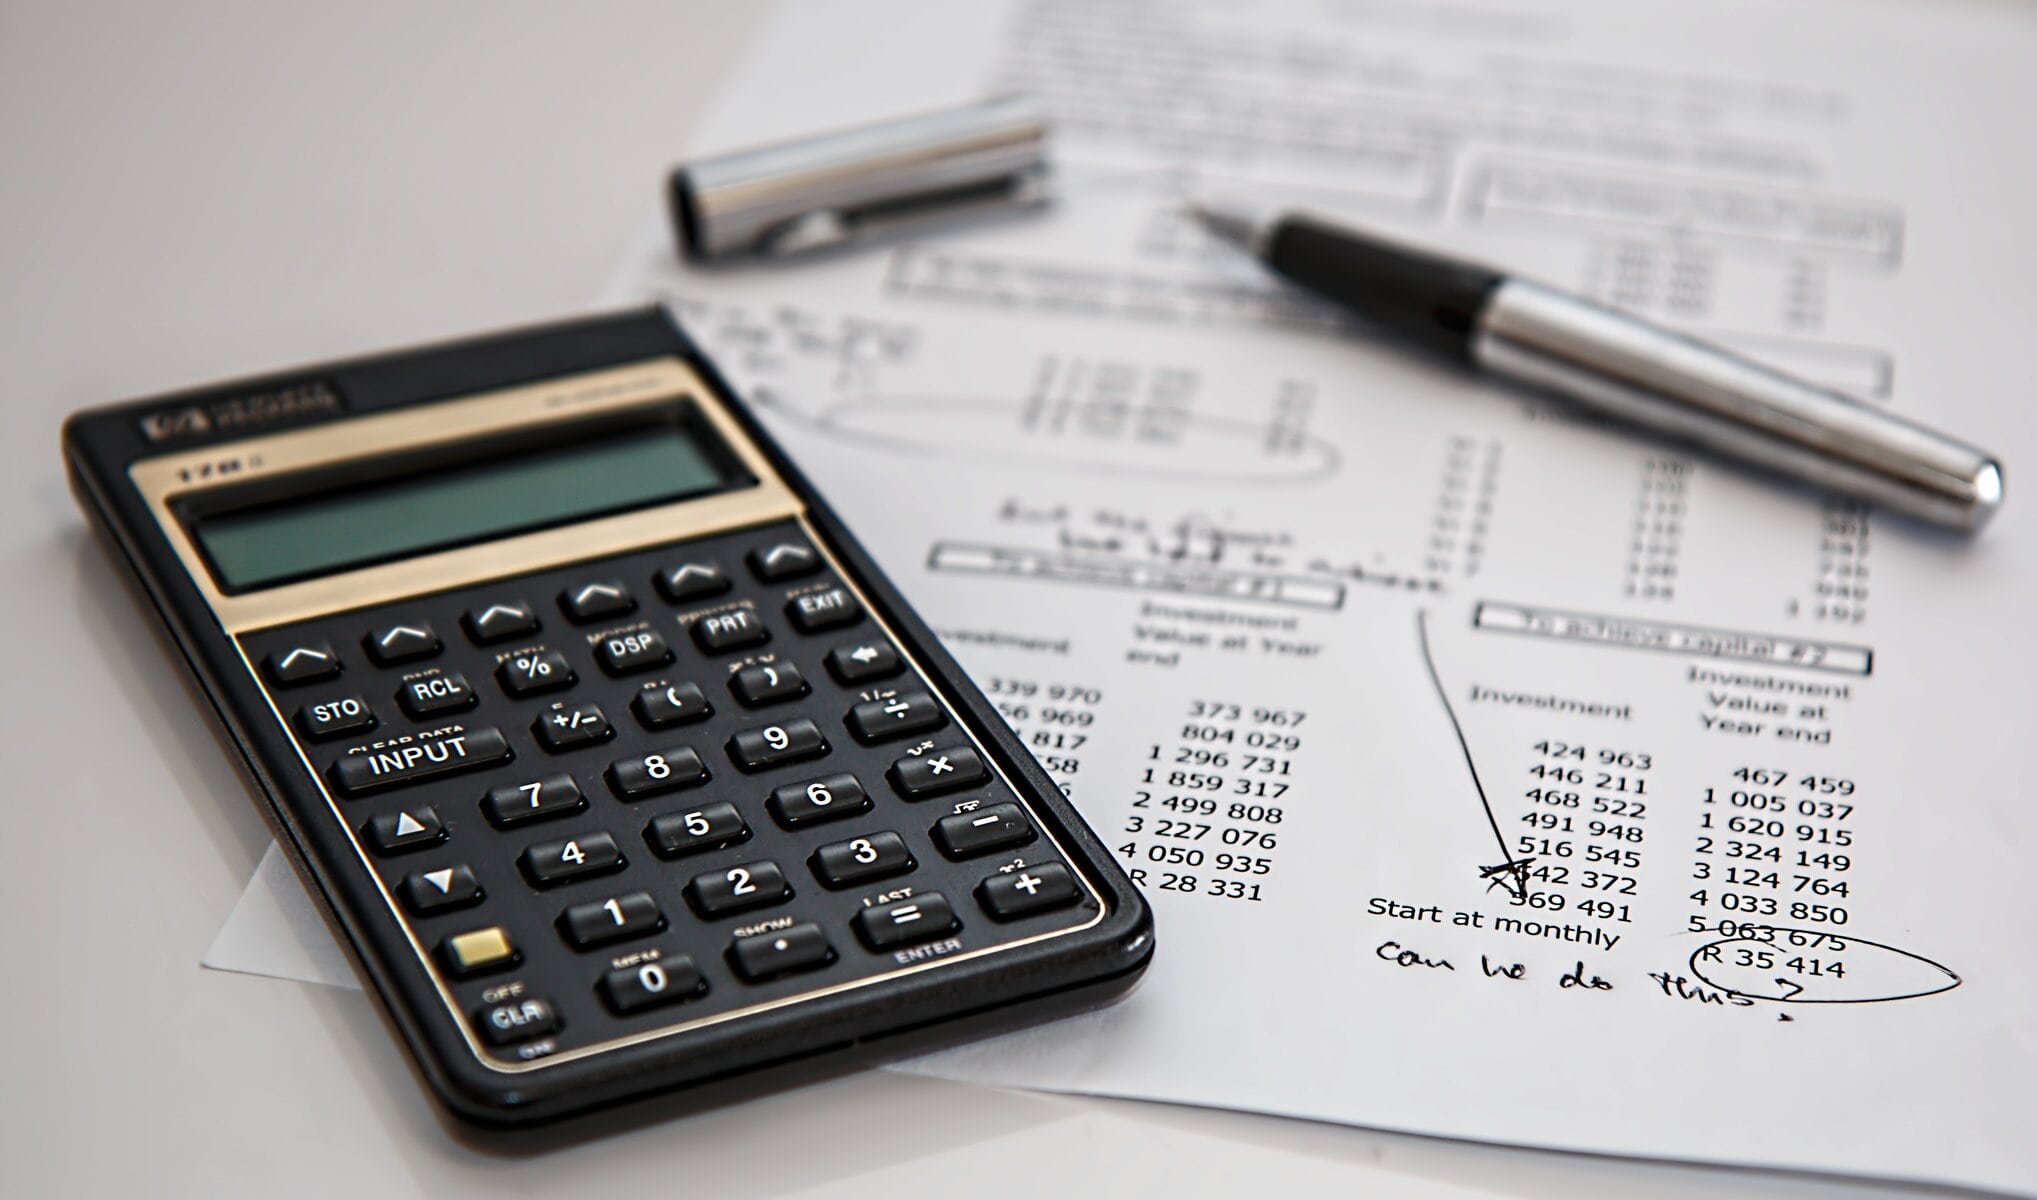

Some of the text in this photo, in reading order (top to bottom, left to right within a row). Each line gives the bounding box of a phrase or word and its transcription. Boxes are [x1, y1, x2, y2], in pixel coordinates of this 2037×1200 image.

[798, 589, 843, 614] EXIT
[1140, 599, 1299, 632] Investment
[705, 611, 747, 635] PRT
[608, 633, 651, 656] DSP
[1132, 624, 1325, 659] Value at Year
[1126, 649, 1181, 669] end
[413, 678, 460, 700] RCL
[988, 677, 1103, 704] 339 970
[1686, 666, 1852, 700] Investment
[313, 699, 360, 722] STO
[999, 702, 1094, 726] 56 969
[1188, 699, 1307, 728] 373 967
[1469, 684, 1634, 720] Investment
[1706, 691, 1828, 721] Value at
[762, 726, 789, 750] 9
[1033, 731, 1087, 751] 817
[1181, 724, 1301, 752] 804 029
[1699, 713, 1832, 745] Year end
[368, 737, 466, 775] INPUT
[643, 754, 671, 779] 8
[1039, 754, 1079, 774] 58
[1150, 745, 1291, 776] 1 296 731
[1533, 740, 1652, 770] 424 963
[806, 782, 833, 806] 6
[1142, 768, 1290, 799] 1 859 317
[1529, 764, 1648, 795] 446 211
[1733, 767, 1856, 796] 467 459
[519, 781, 542, 808] 7
[1132, 791, 1283, 825] 2 499 808
[1525, 788, 1647, 820] 468 522
[1703, 788, 1854, 821] 1 005 037
[684, 811, 711, 836] 5
[1125, 816, 1277, 850] 3 227 076
[1521, 812, 1644, 843] 491 948
[1701, 812, 1853, 846] 1 620 915
[560, 840, 586, 865] 4
[849, 838, 878, 864] 3
[1118, 841, 1272, 876] 4 050 935
[1518, 836, 1641, 869] 516 545
[1695, 836, 1851, 871] 2 324 149
[726, 868, 757, 895] 2
[1129, 868, 1263, 902] R 28 331
[1581, 870, 1637, 896] 372
[1692, 862, 1850, 899] 3 124 764
[603, 897, 626, 926] 1
[1577, 899, 1633, 923] 491
[1689, 889, 1848, 925] 4 033 850
[1366, 897, 1621, 951] Start at monthly
[1688, 915, 1847, 951] 5 063 675
[894, 938, 962, 964] ENTER
[1702, 945, 1846, 979] R 35 414
[638, 964, 669, 992] 0
